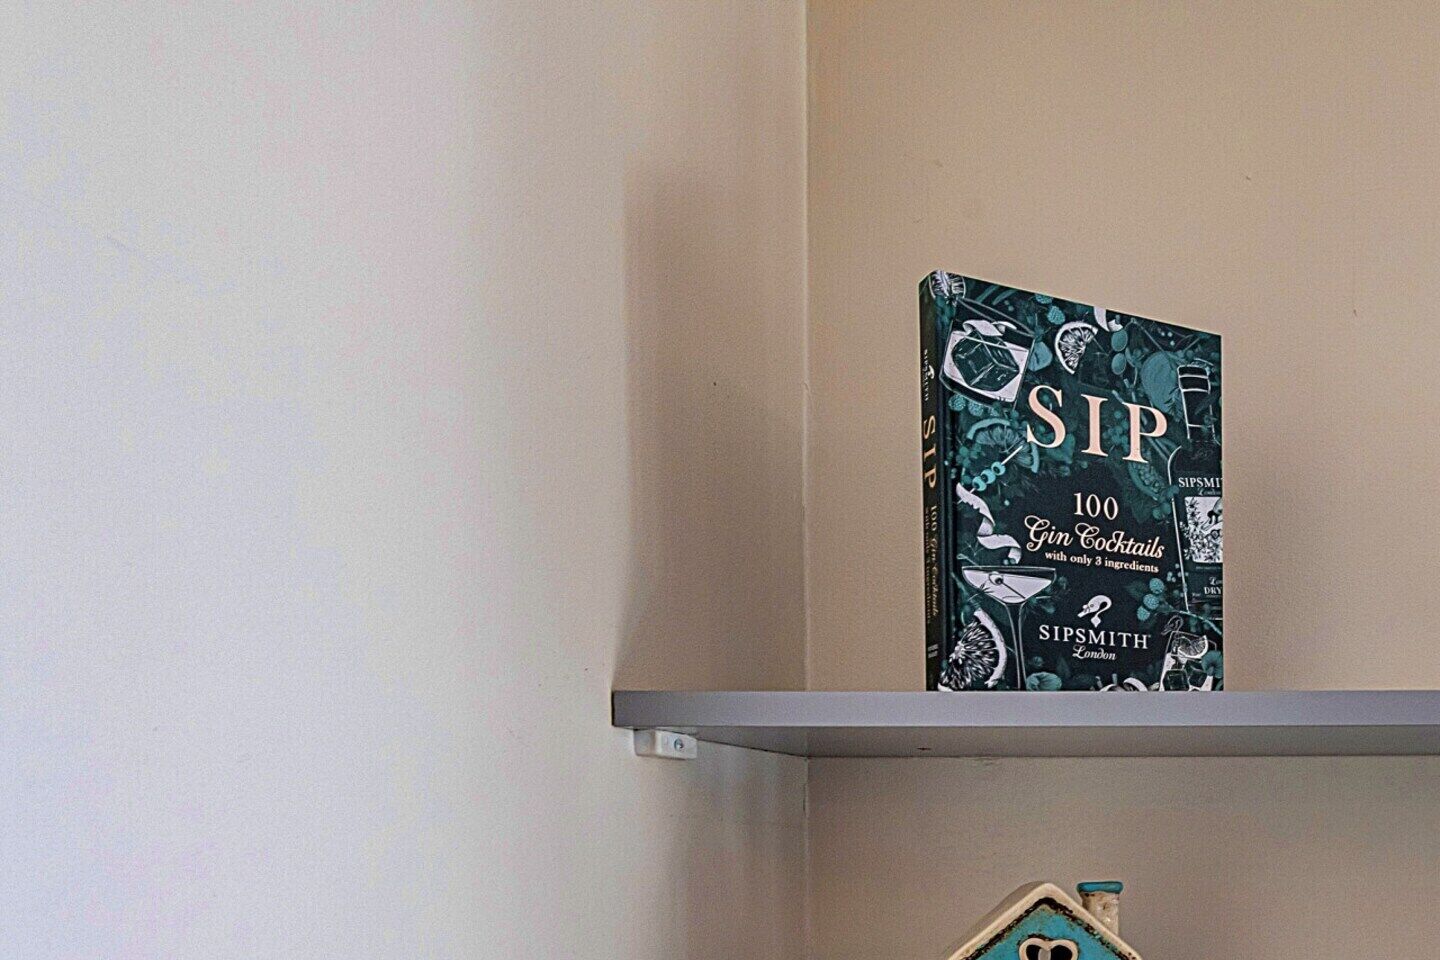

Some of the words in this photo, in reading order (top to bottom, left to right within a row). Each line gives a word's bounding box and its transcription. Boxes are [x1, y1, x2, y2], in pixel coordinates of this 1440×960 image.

[1027, 385, 1168, 463] SIP
[923, 415, 936, 488] SIP
[1073, 492, 1119, 520] 100
[1024, 515, 1073, 551] Gin
[1075, 522, 1165, 558] Cocktails
[1045, 551, 1067, 562] with
[1070, 555, 1092, 566] only
[1095, 557, 1102, 566] 3
[1104, 557, 1159, 573] ingredients
[1039, 624, 1148, 649] SIPSMITH
[1072, 645, 1116, 660] London
